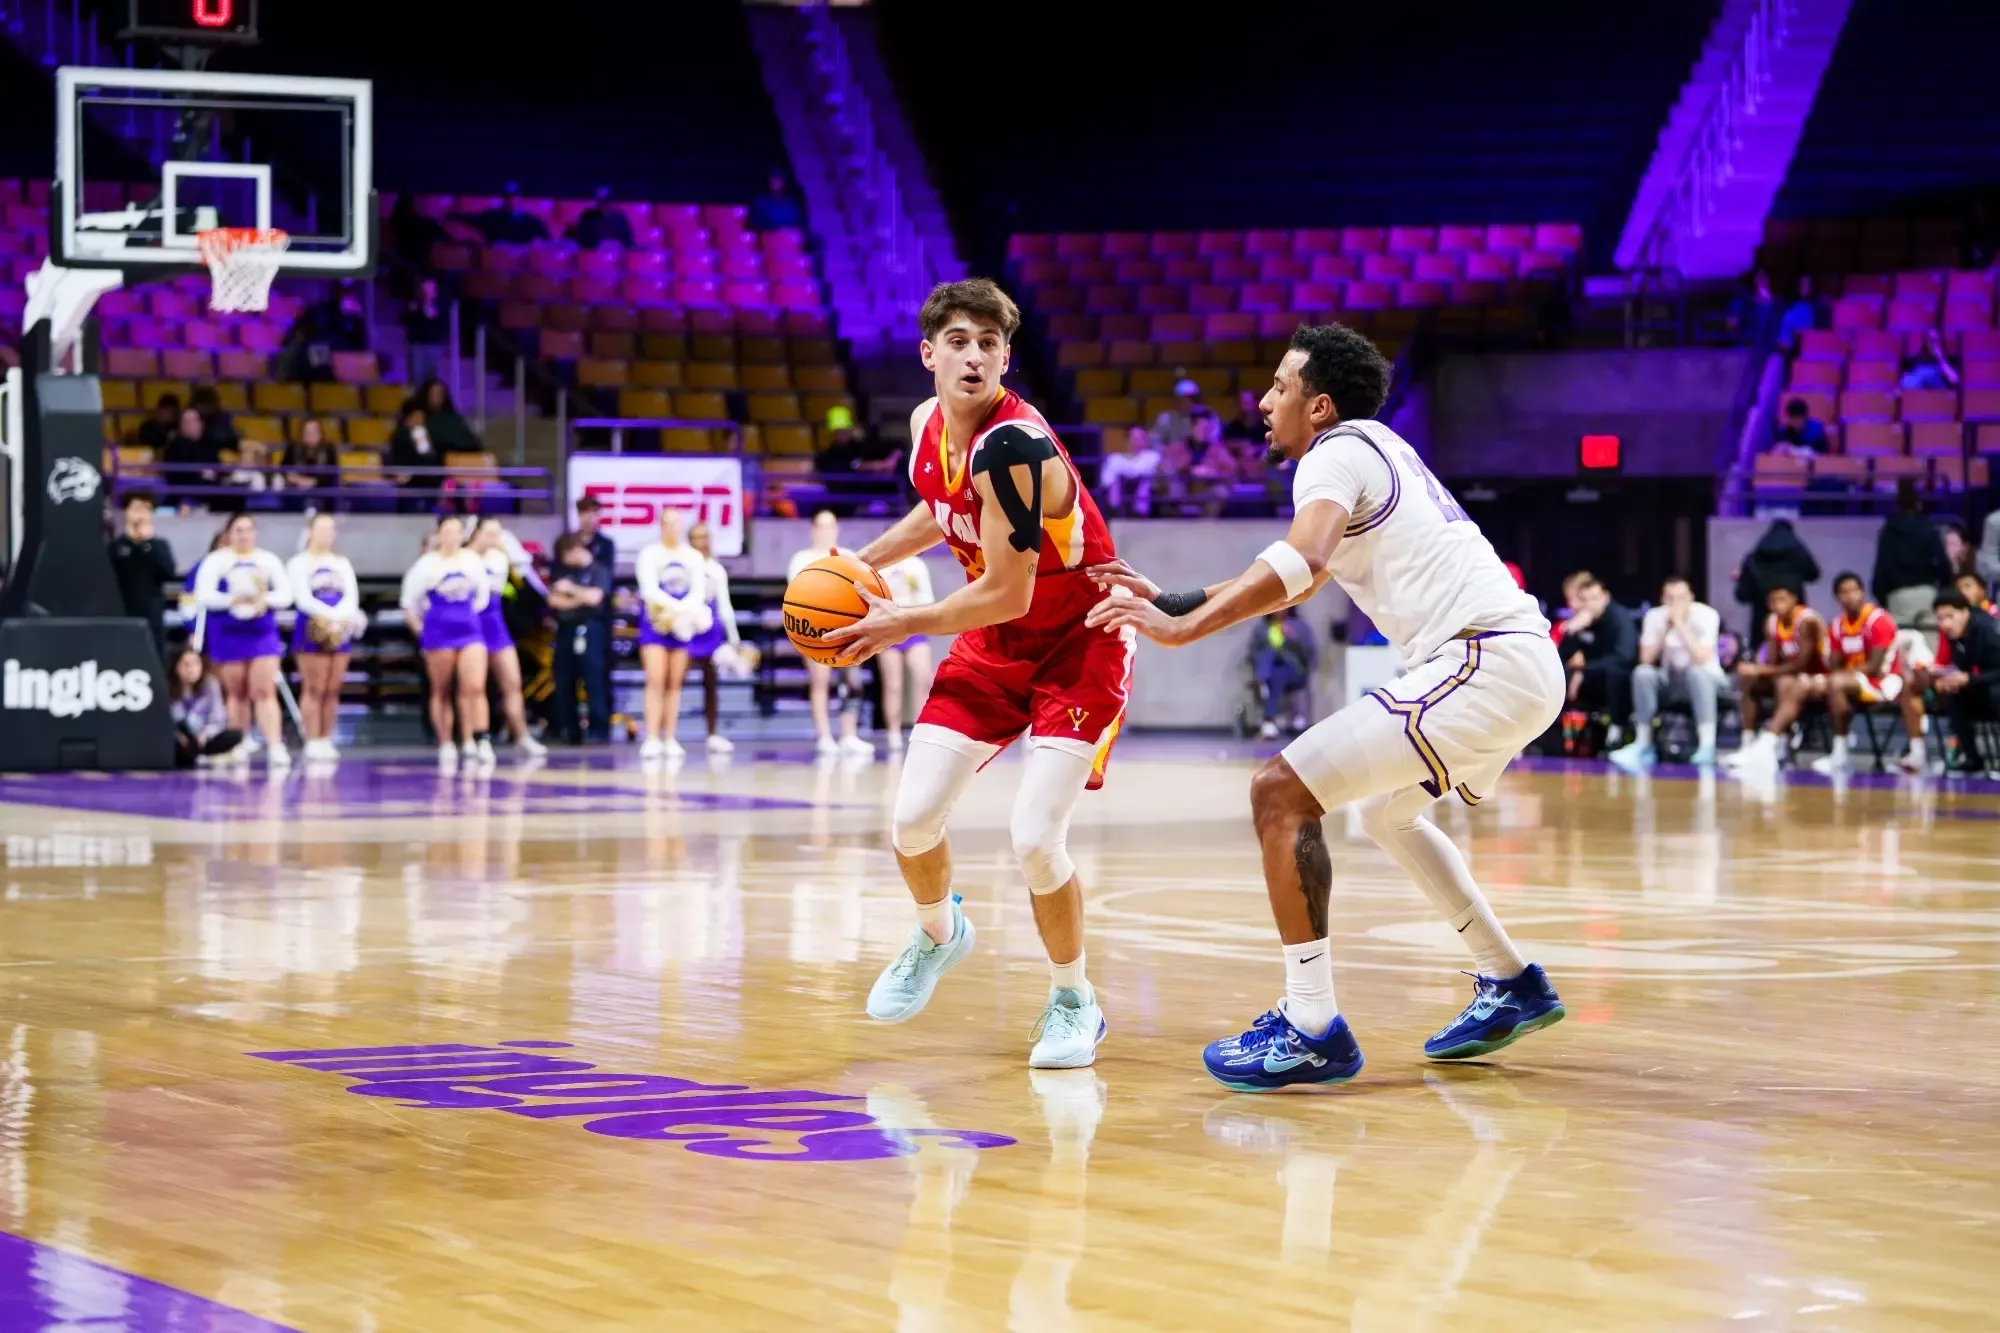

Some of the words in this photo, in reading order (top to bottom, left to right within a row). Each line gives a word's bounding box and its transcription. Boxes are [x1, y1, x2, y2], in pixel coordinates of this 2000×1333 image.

[583, 485, 732, 527] ESPN
[783, 610, 839, 639] Wilso
[4, 658, 153, 718] ingles
[243, 1039, 1017, 1162] ingles
